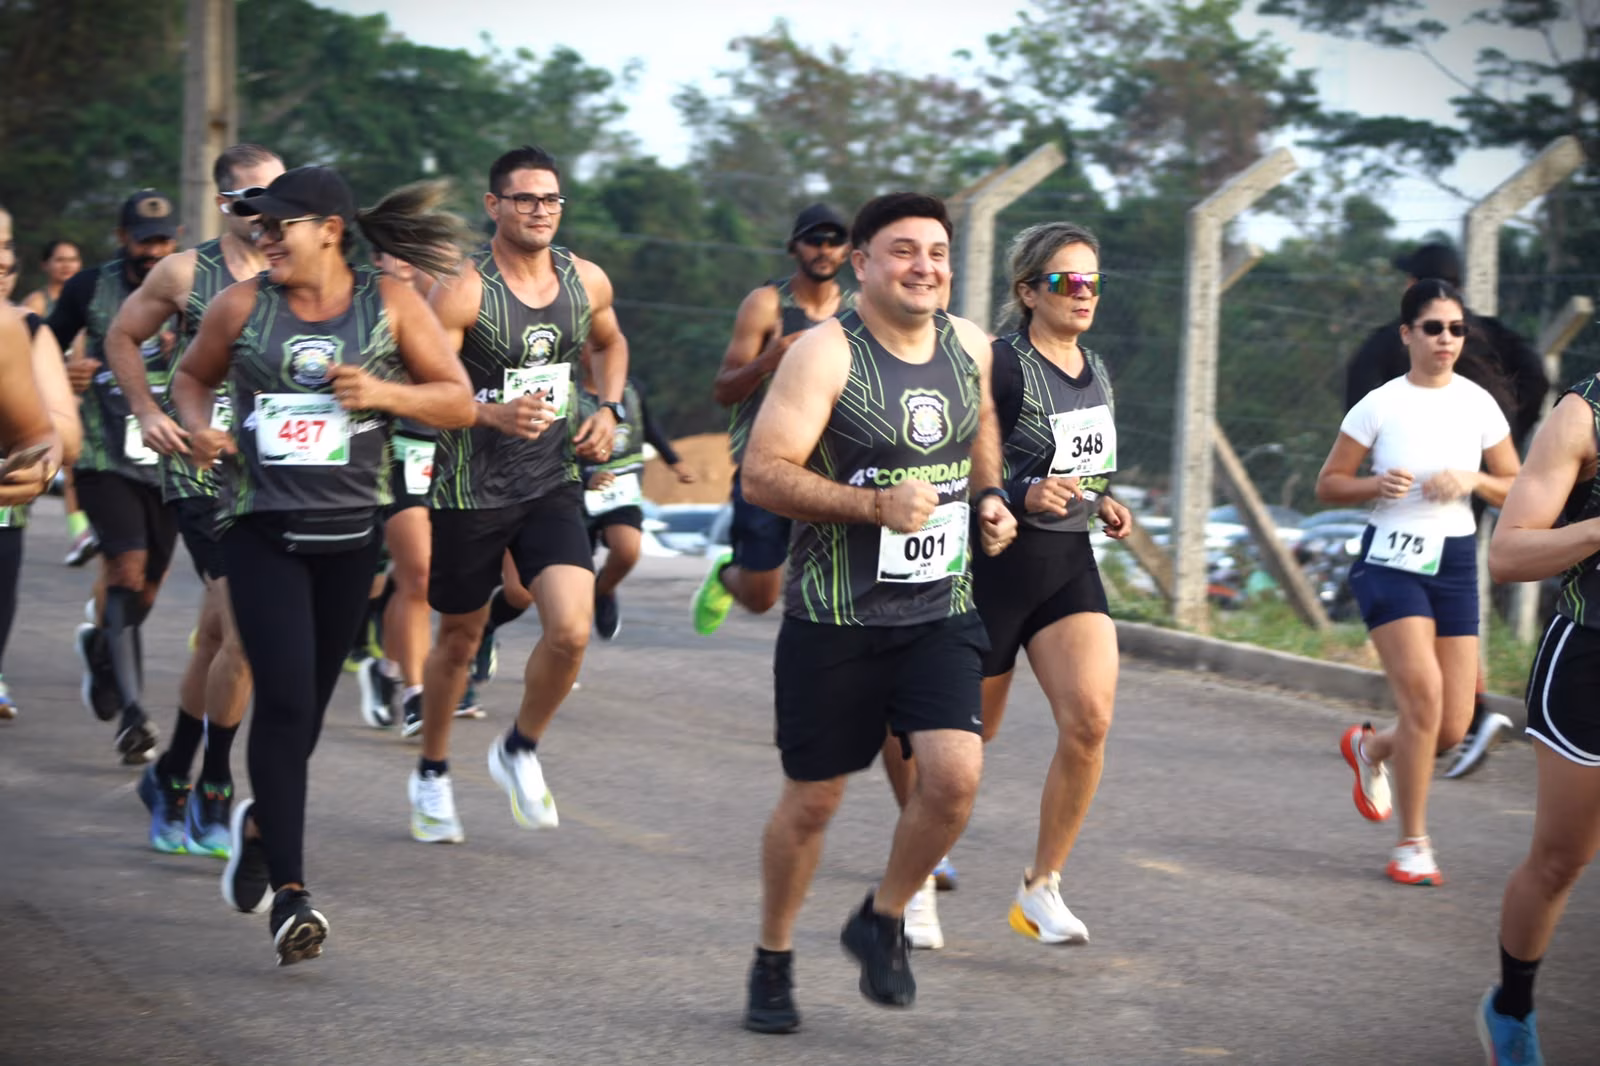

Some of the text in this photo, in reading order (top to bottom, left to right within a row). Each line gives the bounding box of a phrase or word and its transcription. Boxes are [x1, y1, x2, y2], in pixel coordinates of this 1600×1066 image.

[278, 420, 327, 443] 487
[1071, 432, 1103, 458] 348
[904, 532, 946, 561] 001
[1388, 531, 1425, 554] 175
